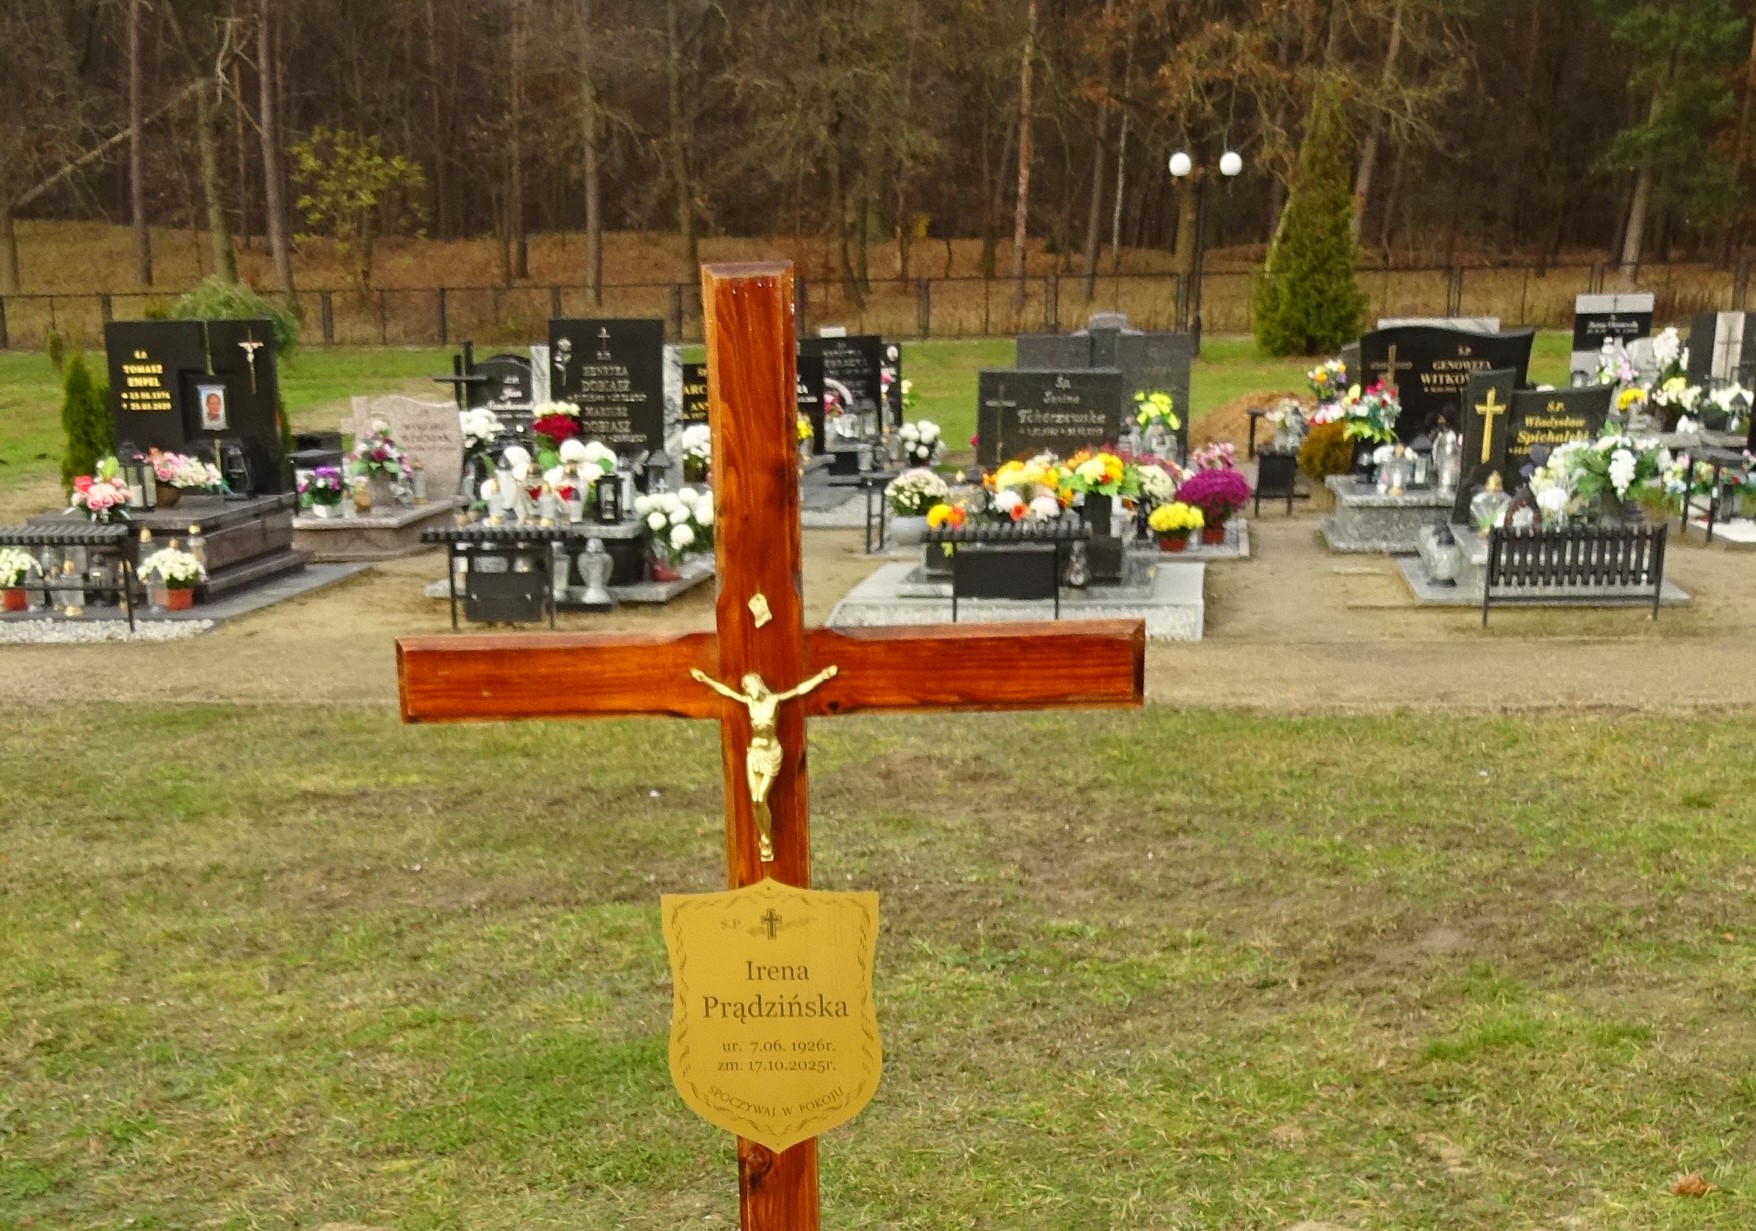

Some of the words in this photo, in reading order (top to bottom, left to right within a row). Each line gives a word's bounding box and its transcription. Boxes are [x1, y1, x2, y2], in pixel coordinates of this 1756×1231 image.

[122, 364, 163, 374] TOMASZ
[127, 376, 161, 388] EMPEL
[745, 960, 810, 981] Irena
[702, 994, 849, 1025] Prądzińska
[722, 1041, 743, 1053] ur.
[791, 1039, 837, 1054] 1926r.
[718, 1060, 744, 1072] zm.
[748, 1060, 837, 1074] 17.10.2025r.
[708, 1085, 776, 1118] SPOCZYWAJ
[781, 1106, 794, 1117] W
[799, 1086, 845, 1114] POKOJU
